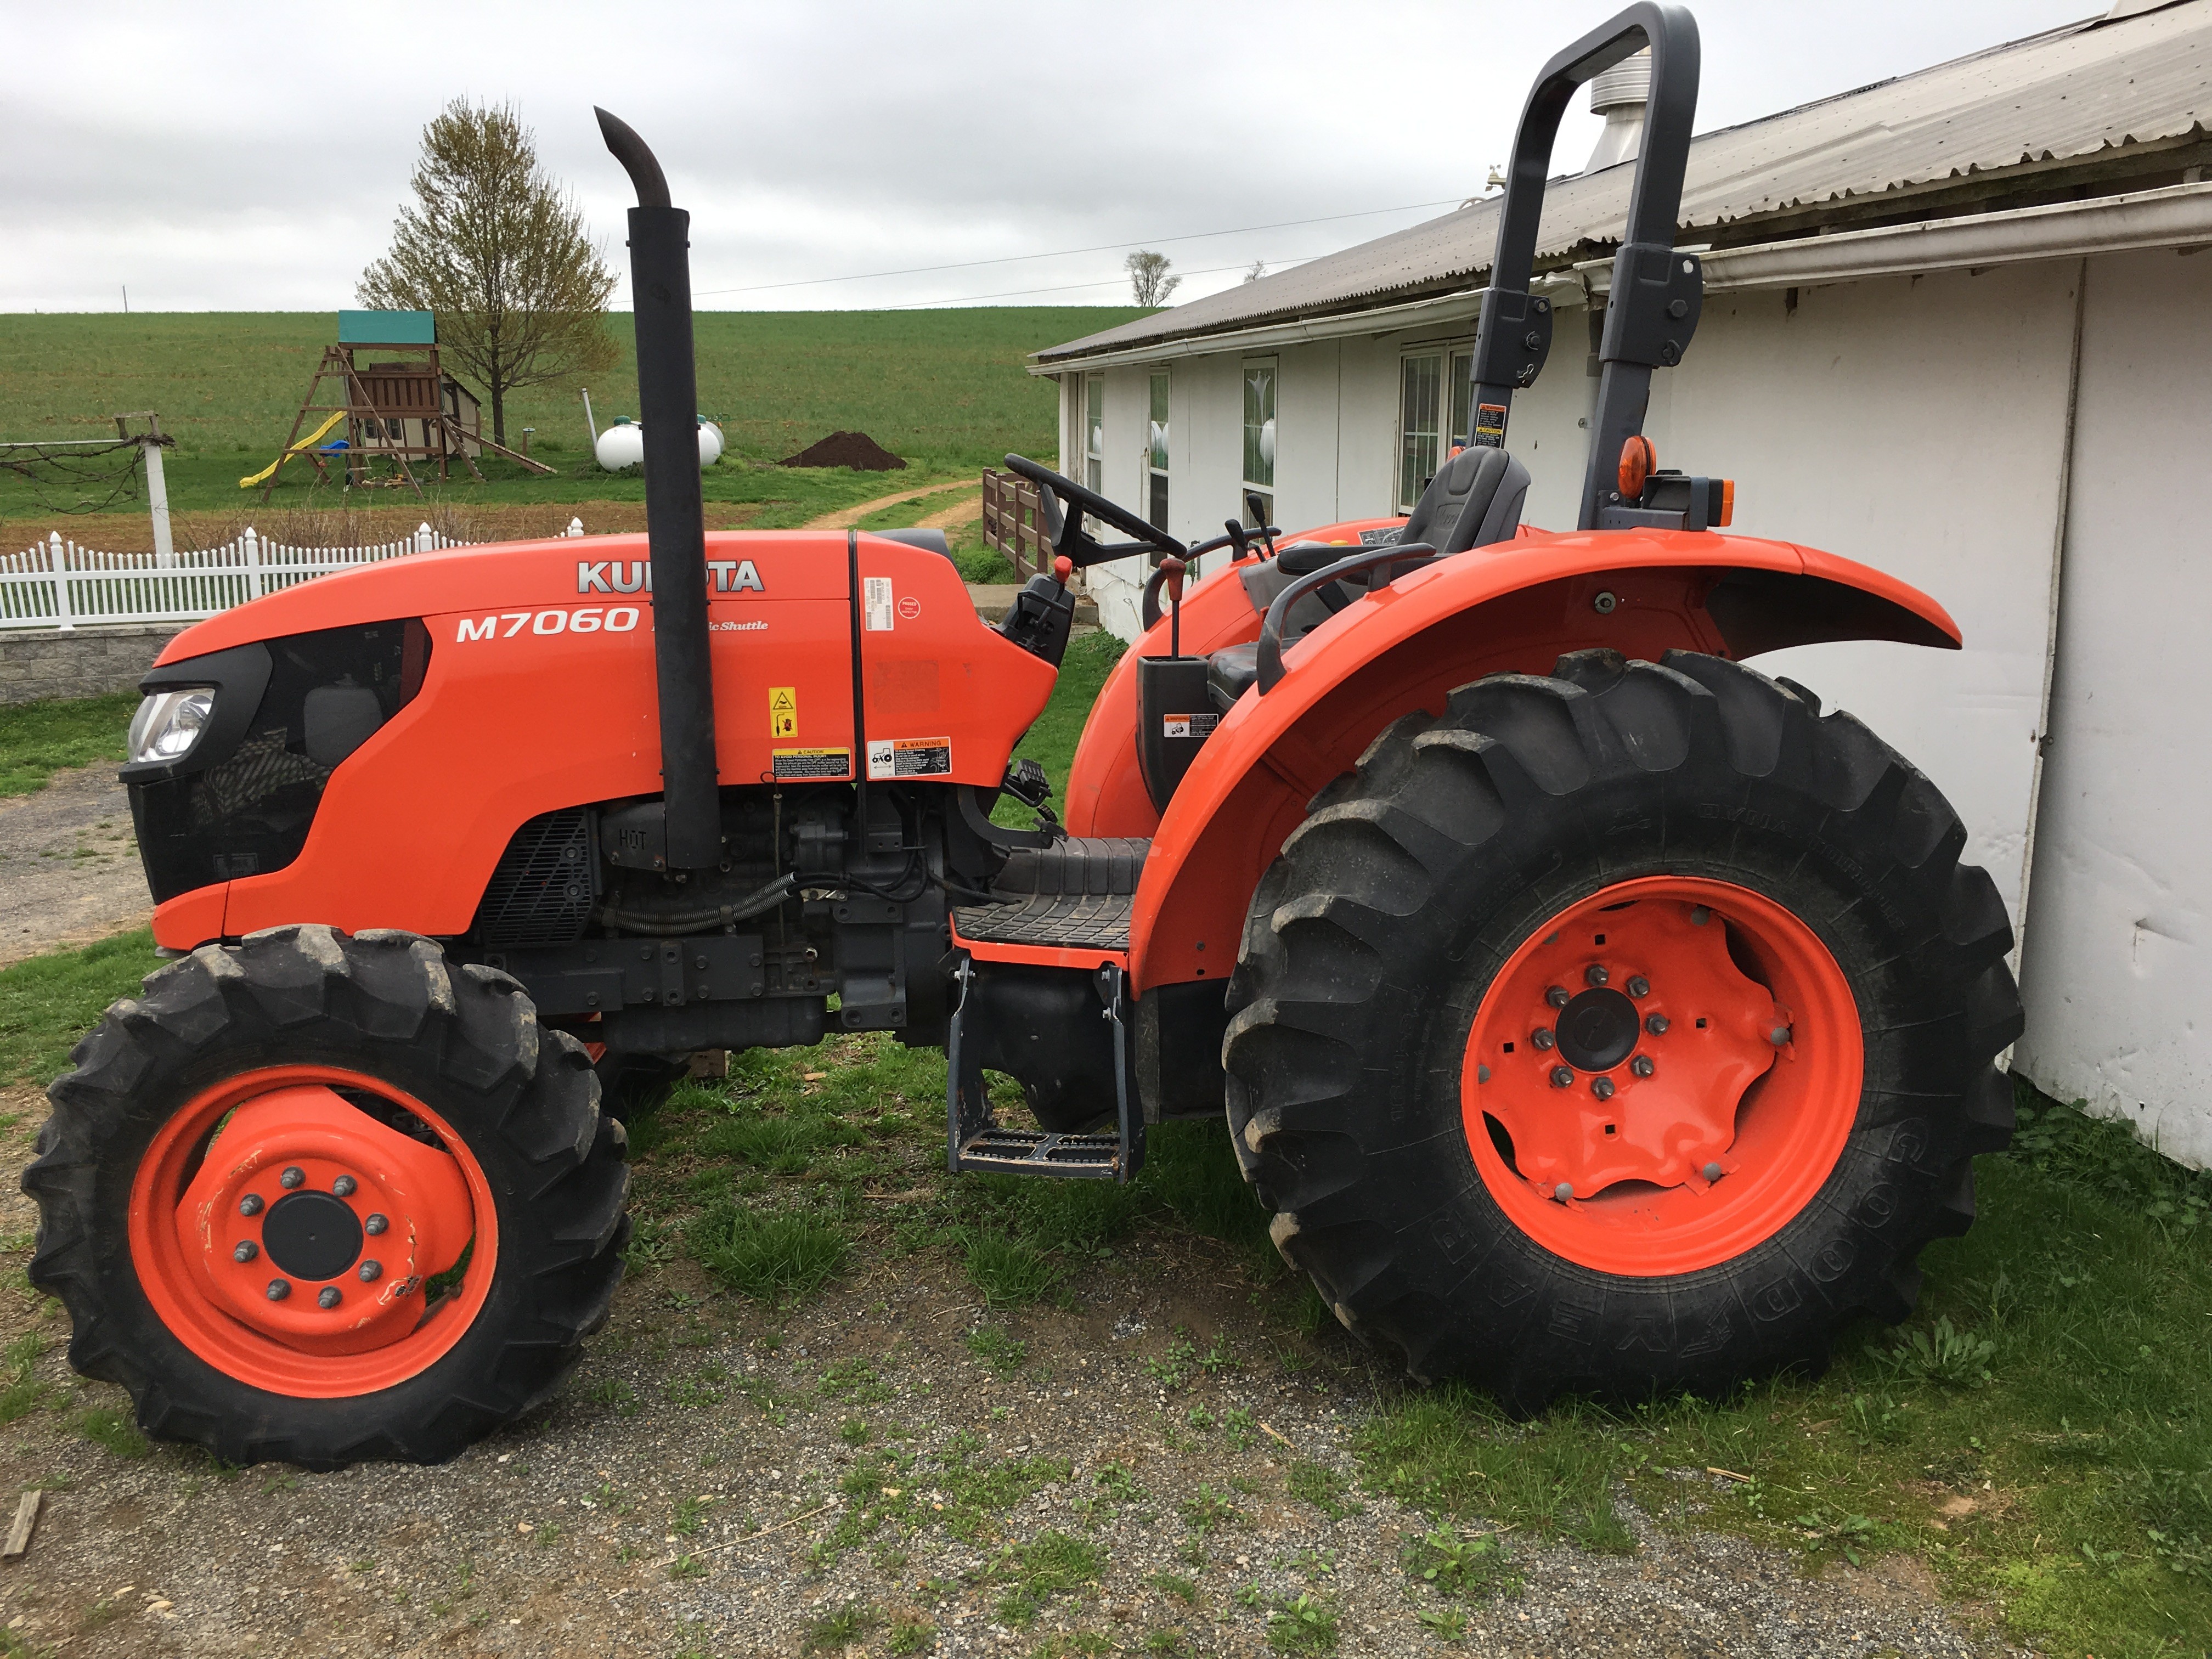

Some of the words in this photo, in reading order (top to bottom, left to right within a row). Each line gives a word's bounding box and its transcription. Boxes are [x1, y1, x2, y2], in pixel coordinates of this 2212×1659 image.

[578, 560, 765, 594] KUTA
[456, 607, 640, 643] M7060
[720, 620, 769, 631] Shuttle
[619, 829, 646, 850] HOT
